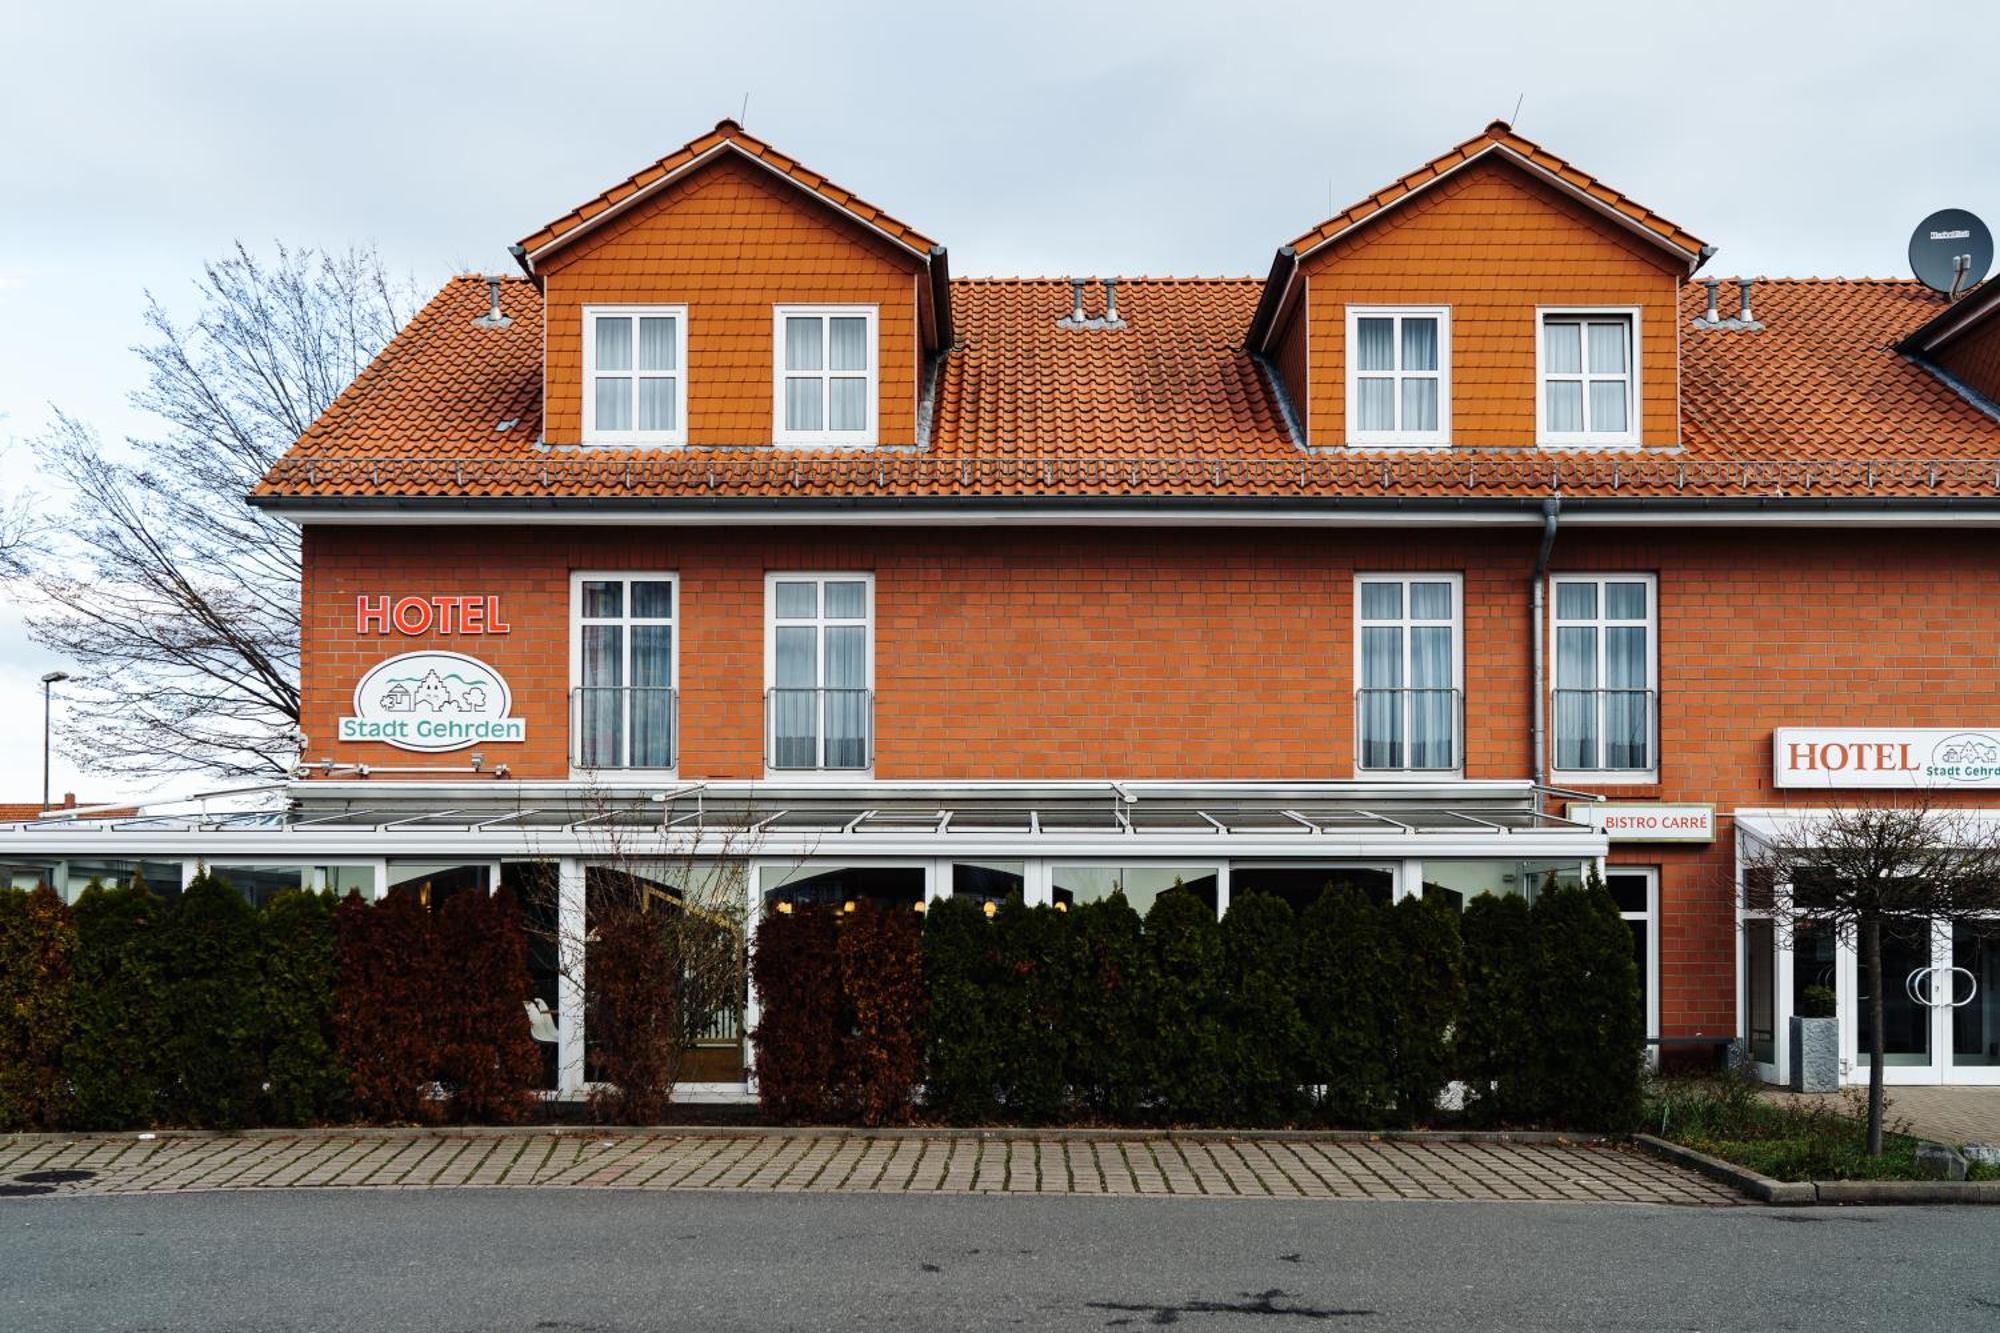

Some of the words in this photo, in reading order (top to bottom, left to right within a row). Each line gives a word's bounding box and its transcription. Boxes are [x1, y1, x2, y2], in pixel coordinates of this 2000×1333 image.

[357, 595, 510, 636] HOTEL
[344, 719, 408, 738] Stadt
[417, 719, 521, 738] Gehrden
[1787, 743, 1921, 771] HOTEL
[1926, 765, 1961, 777] Stadt
[1605, 816, 1657, 829] BISTRO
[1661, 813, 1707, 829] CARRÉ
